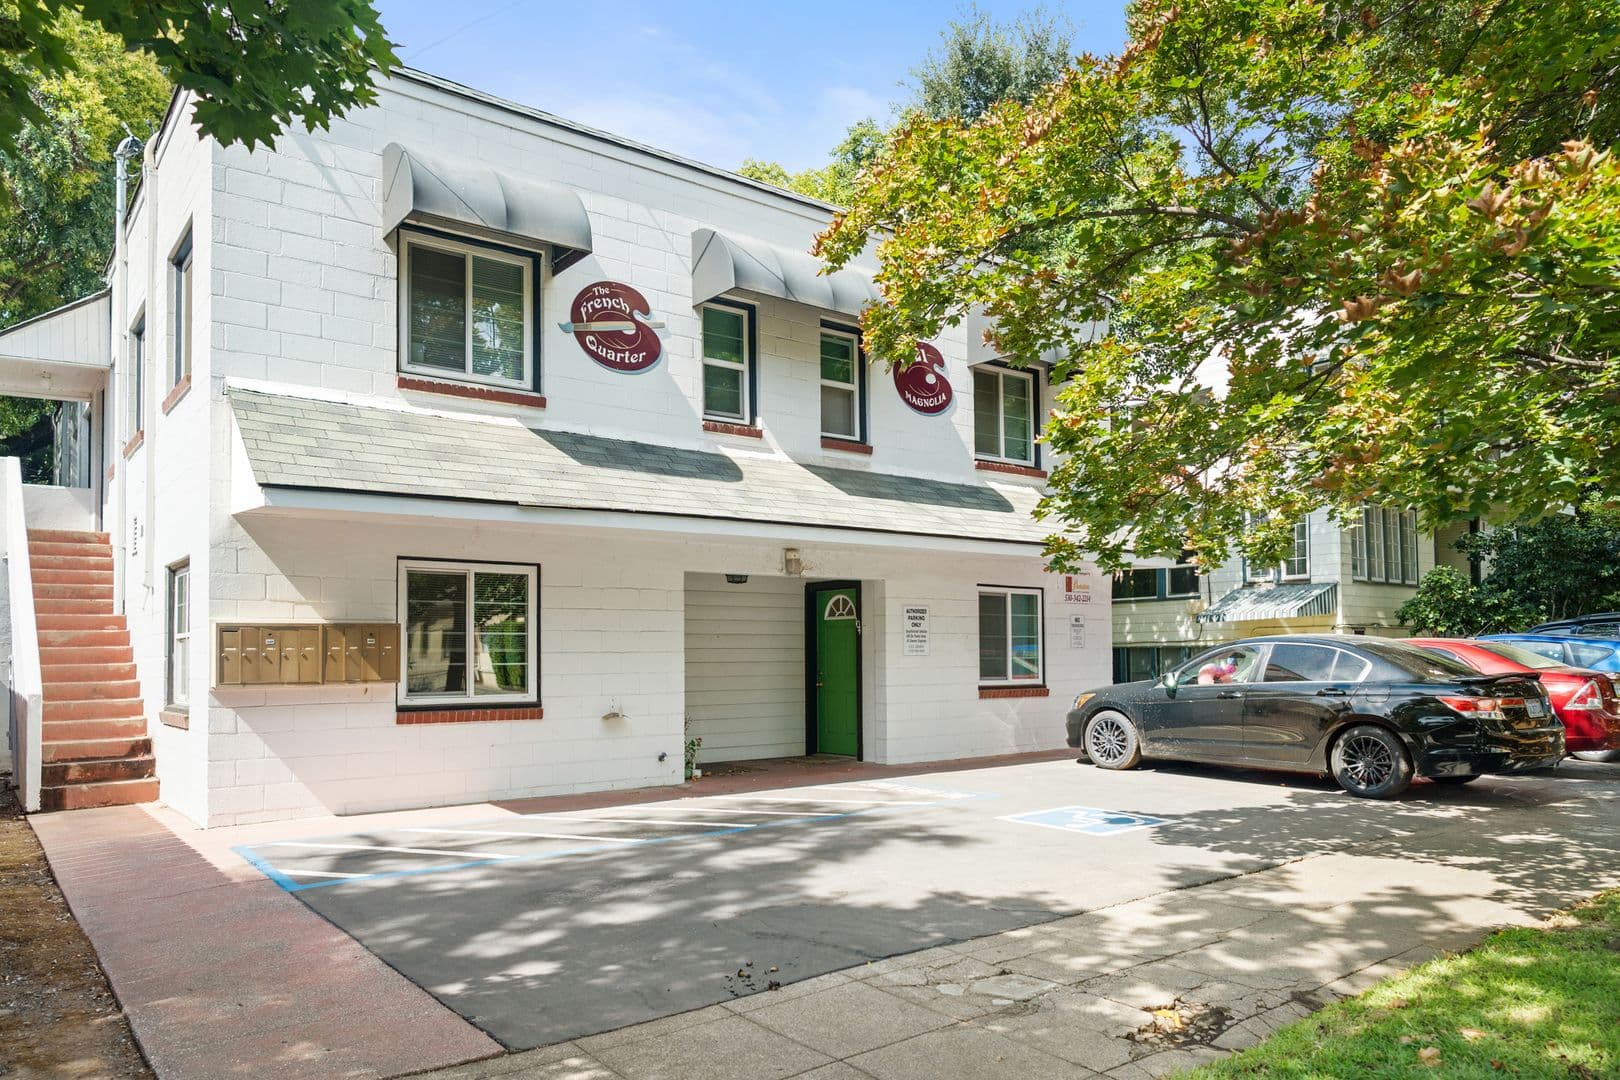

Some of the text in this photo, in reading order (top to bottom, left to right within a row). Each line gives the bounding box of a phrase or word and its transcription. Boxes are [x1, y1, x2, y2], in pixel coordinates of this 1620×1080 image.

[592, 286, 610, 296] The
[585, 335, 647, 364] Quarter
[904, 390, 947, 408] MAGNOLIA
